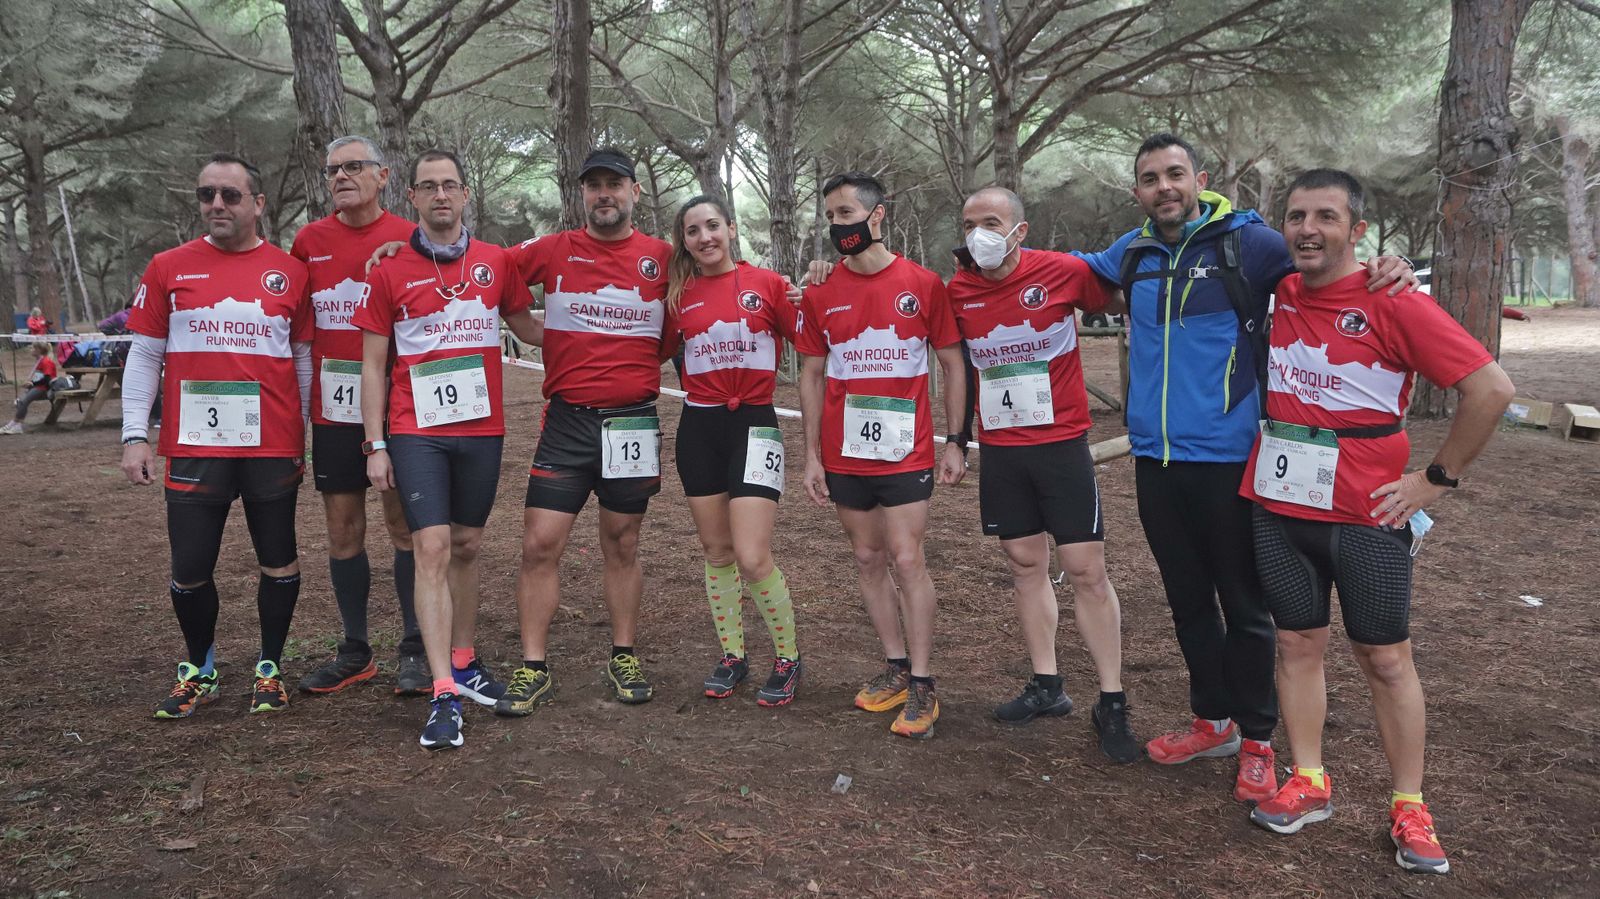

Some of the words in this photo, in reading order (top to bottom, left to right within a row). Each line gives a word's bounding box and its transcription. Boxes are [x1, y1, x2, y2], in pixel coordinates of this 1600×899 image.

[840, 233, 861, 249] RSR
[315, 301, 340, 313] SAN
[569, 303, 600, 317] SAN
[603, 306, 652, 322] ROQUE
[188, 320, 219, 333] SAN
[224, 321, 273, 338] ROQUE
[423, 321, 451, 336] SAN
[454, 318, 493, 332] ROQUE
[586, 318, 633, 331] RUNNING
[206, 335, 257, 348] RUNNING
[439, 332, 483, 344] RUNNING
[694, 342, 717, 358] SAN
[720, 340, 758, 352] ROQUE
[865, 348, 909, 362] ROQUE
[971, 347, 998, 359] SAN
[1000, 337, 1051, 355] ROQUE
[709, 354, 744, 365] RUNNING
[852, 363, 893, 373] RUNNING
[1290, 367, 1343, 391] ROQUE
[333, 384, 354, 406] 41
[433, 384, 458, 406] 19
[1001, 389, 1013, 410] 4
[207, 407, 219, 428] 3
[860, 421, 882, 442] 48
[621, 441, 641, 461] 13
[765, 450, 782, 473] 52
[1275, 454, 1288, 479] 9
